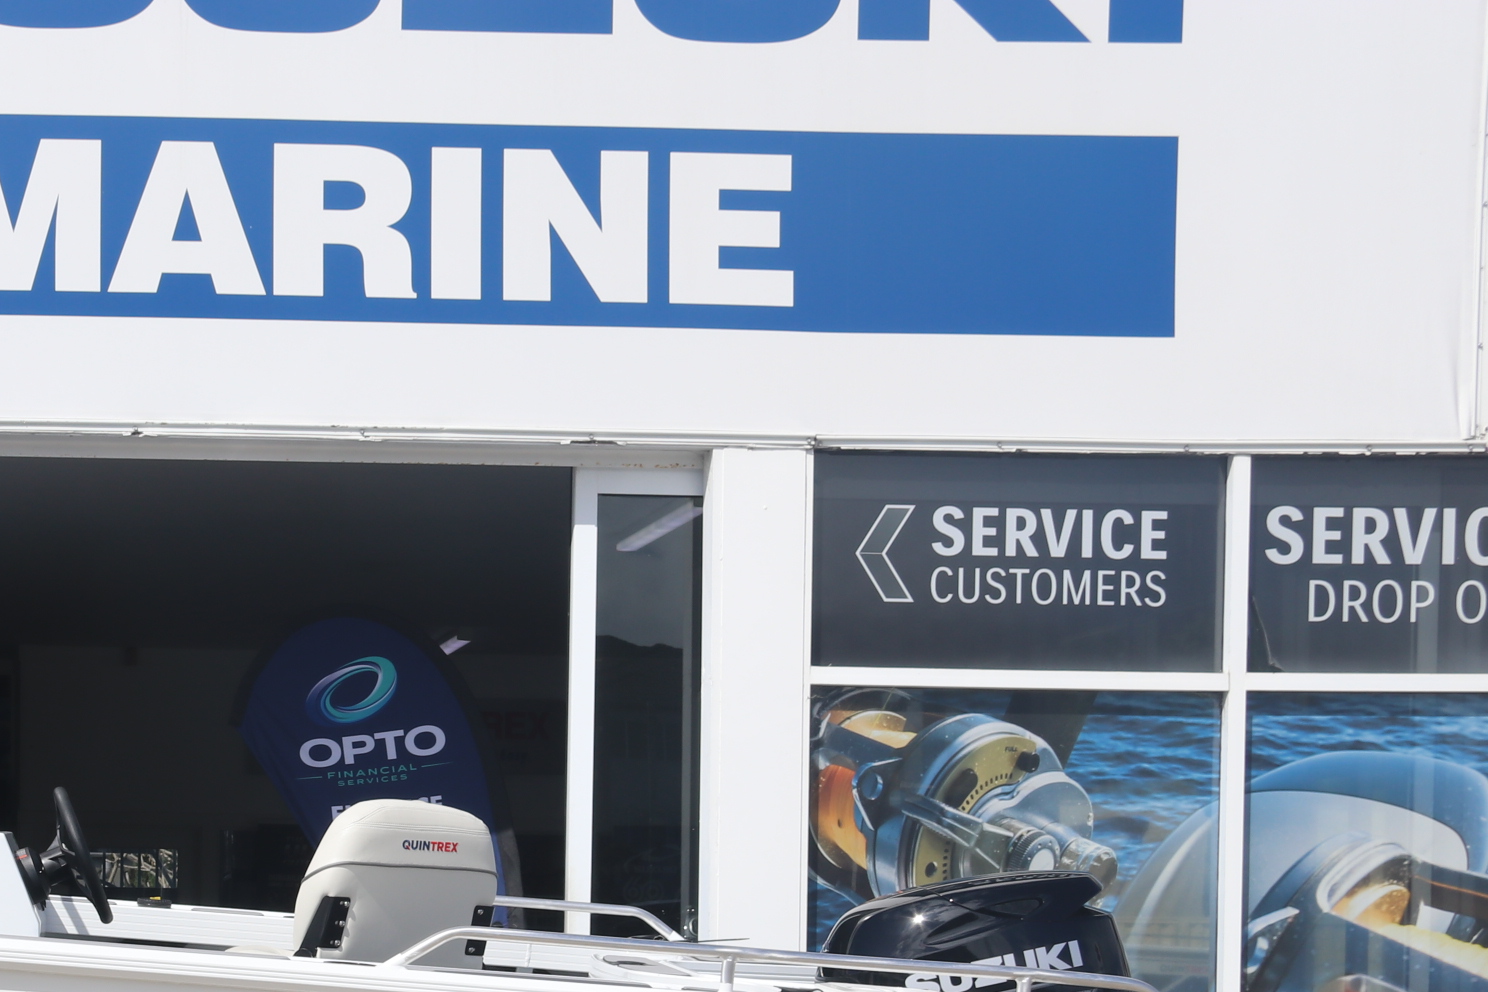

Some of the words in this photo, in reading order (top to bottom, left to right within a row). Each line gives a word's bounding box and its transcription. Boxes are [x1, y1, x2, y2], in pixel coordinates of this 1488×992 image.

[931, 505, 1169, 561] SERVICE
[929, 566, 1166, 608] CUSTOMERS
[1307, 578, 1435, 624] DROP
[299, 724, 447, 768] OPTO
[327, 763, 418, 779] FINANCIAL
[337, 773, 408, 787] SERVICES
[402, 839, 459, 853] QUINTREX
